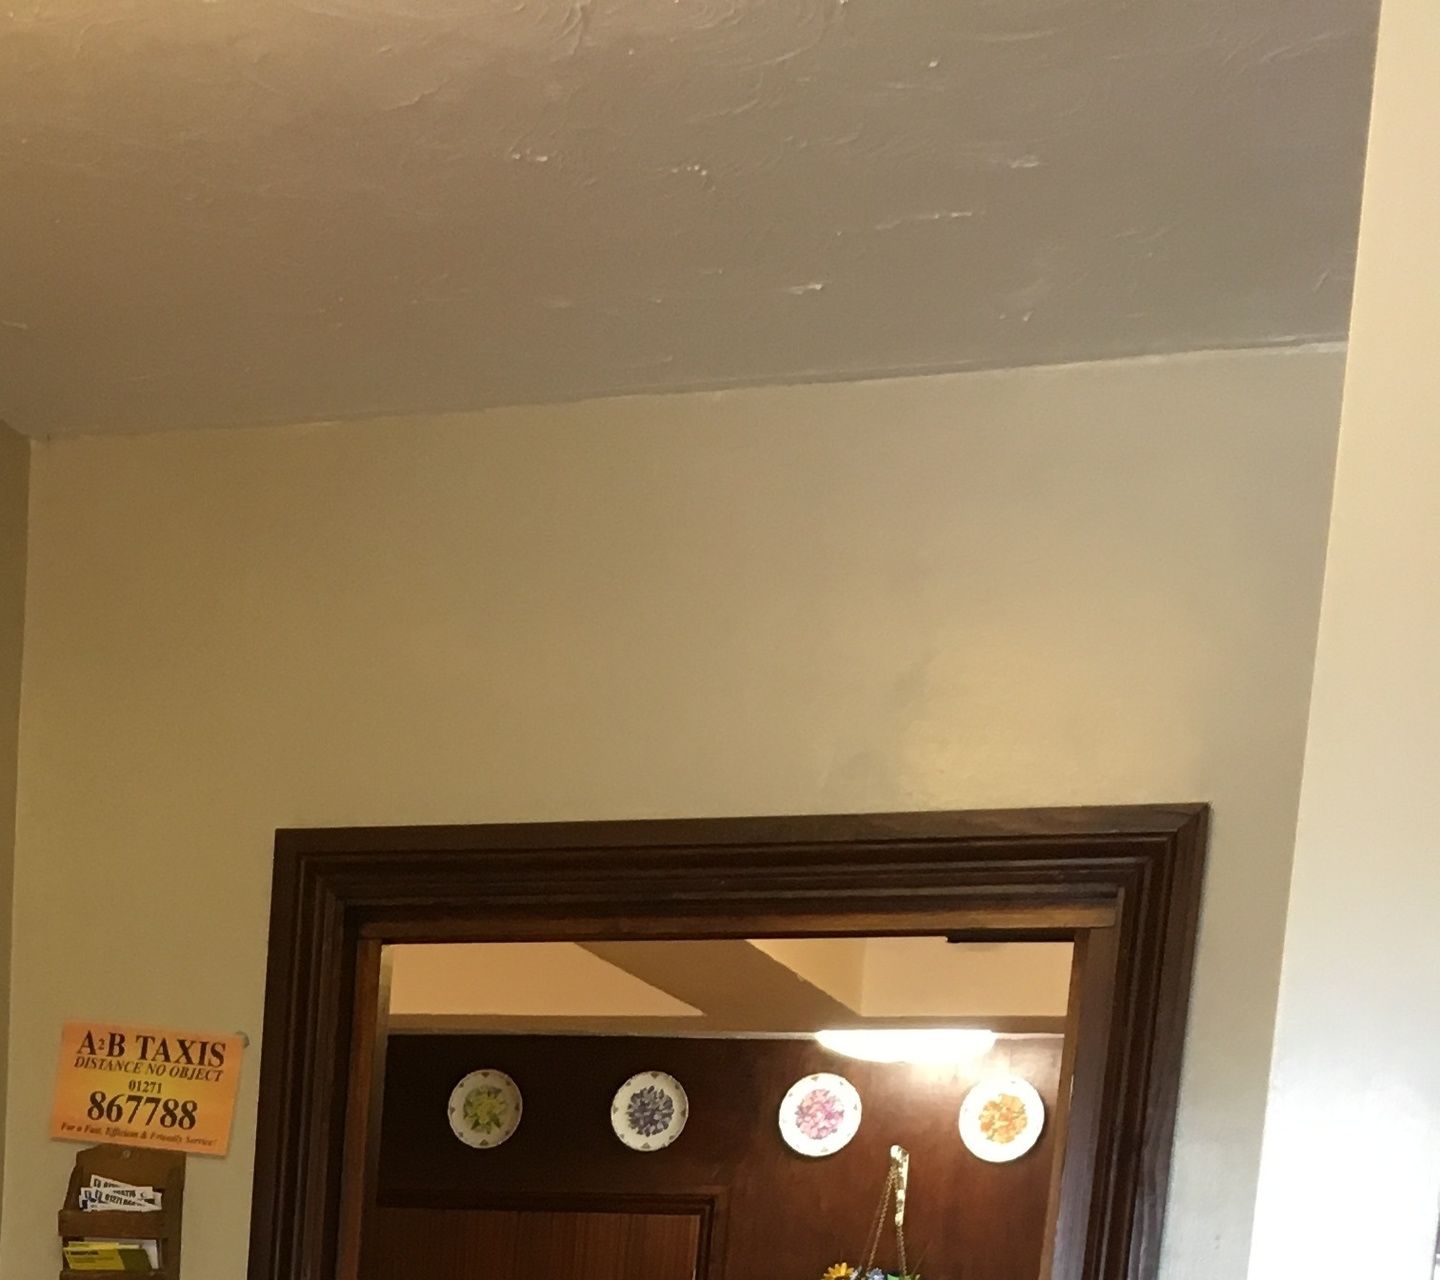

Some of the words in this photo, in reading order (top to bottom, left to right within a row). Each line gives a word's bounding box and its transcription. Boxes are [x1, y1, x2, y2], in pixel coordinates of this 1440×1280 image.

[135, 1034, 227, 1068] TAXIS
[74, 1056, 142, 1074] DISTANCE
[146, 1062, 167, 1077] NO
[169, 1066, 224, 1082] OBJECT
[128, 1079, 163, 1094] 01271
[87, 1090, 198, 1130] 867788
